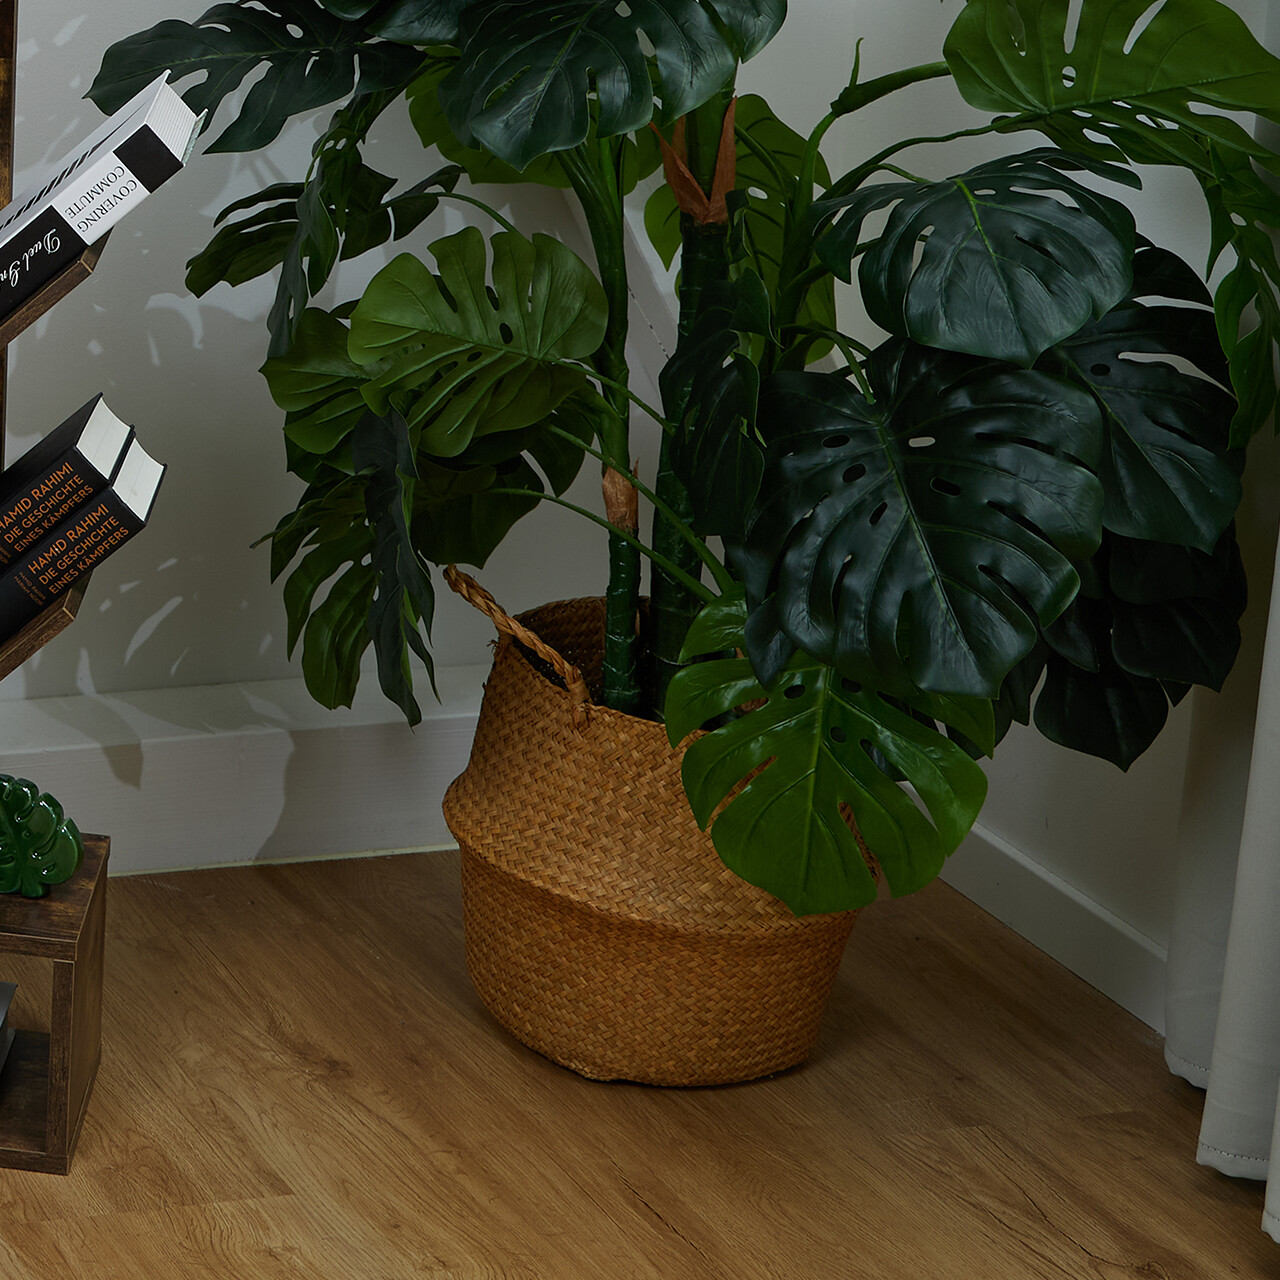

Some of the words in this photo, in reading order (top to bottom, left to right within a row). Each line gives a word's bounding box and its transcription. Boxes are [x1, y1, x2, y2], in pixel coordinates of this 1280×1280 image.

[65, 165, 125, 219] COMMUTE
[77, 179, 137, 233] COVERING
[22, 228, 61, 272] Duel
[3, 525, 23, 544] DIE
[21, 476, 84, 531] GESCHICHTE
[31, 462, 74, 500] RAHIMI
[13, 526, 43, 552] EINES
[41, 485, 94, 529] KÄMPFERS
[27, 539, 67, 574] HAMID
[66, 504, 109, 542] RAHIMI
[38, 566, 58, 585] DIE
[56, 516, 119, 572] GESCHICHTE
[48, 567, 79, 595] EINES
[77, 527, 129, 571] KÄMPFERS
